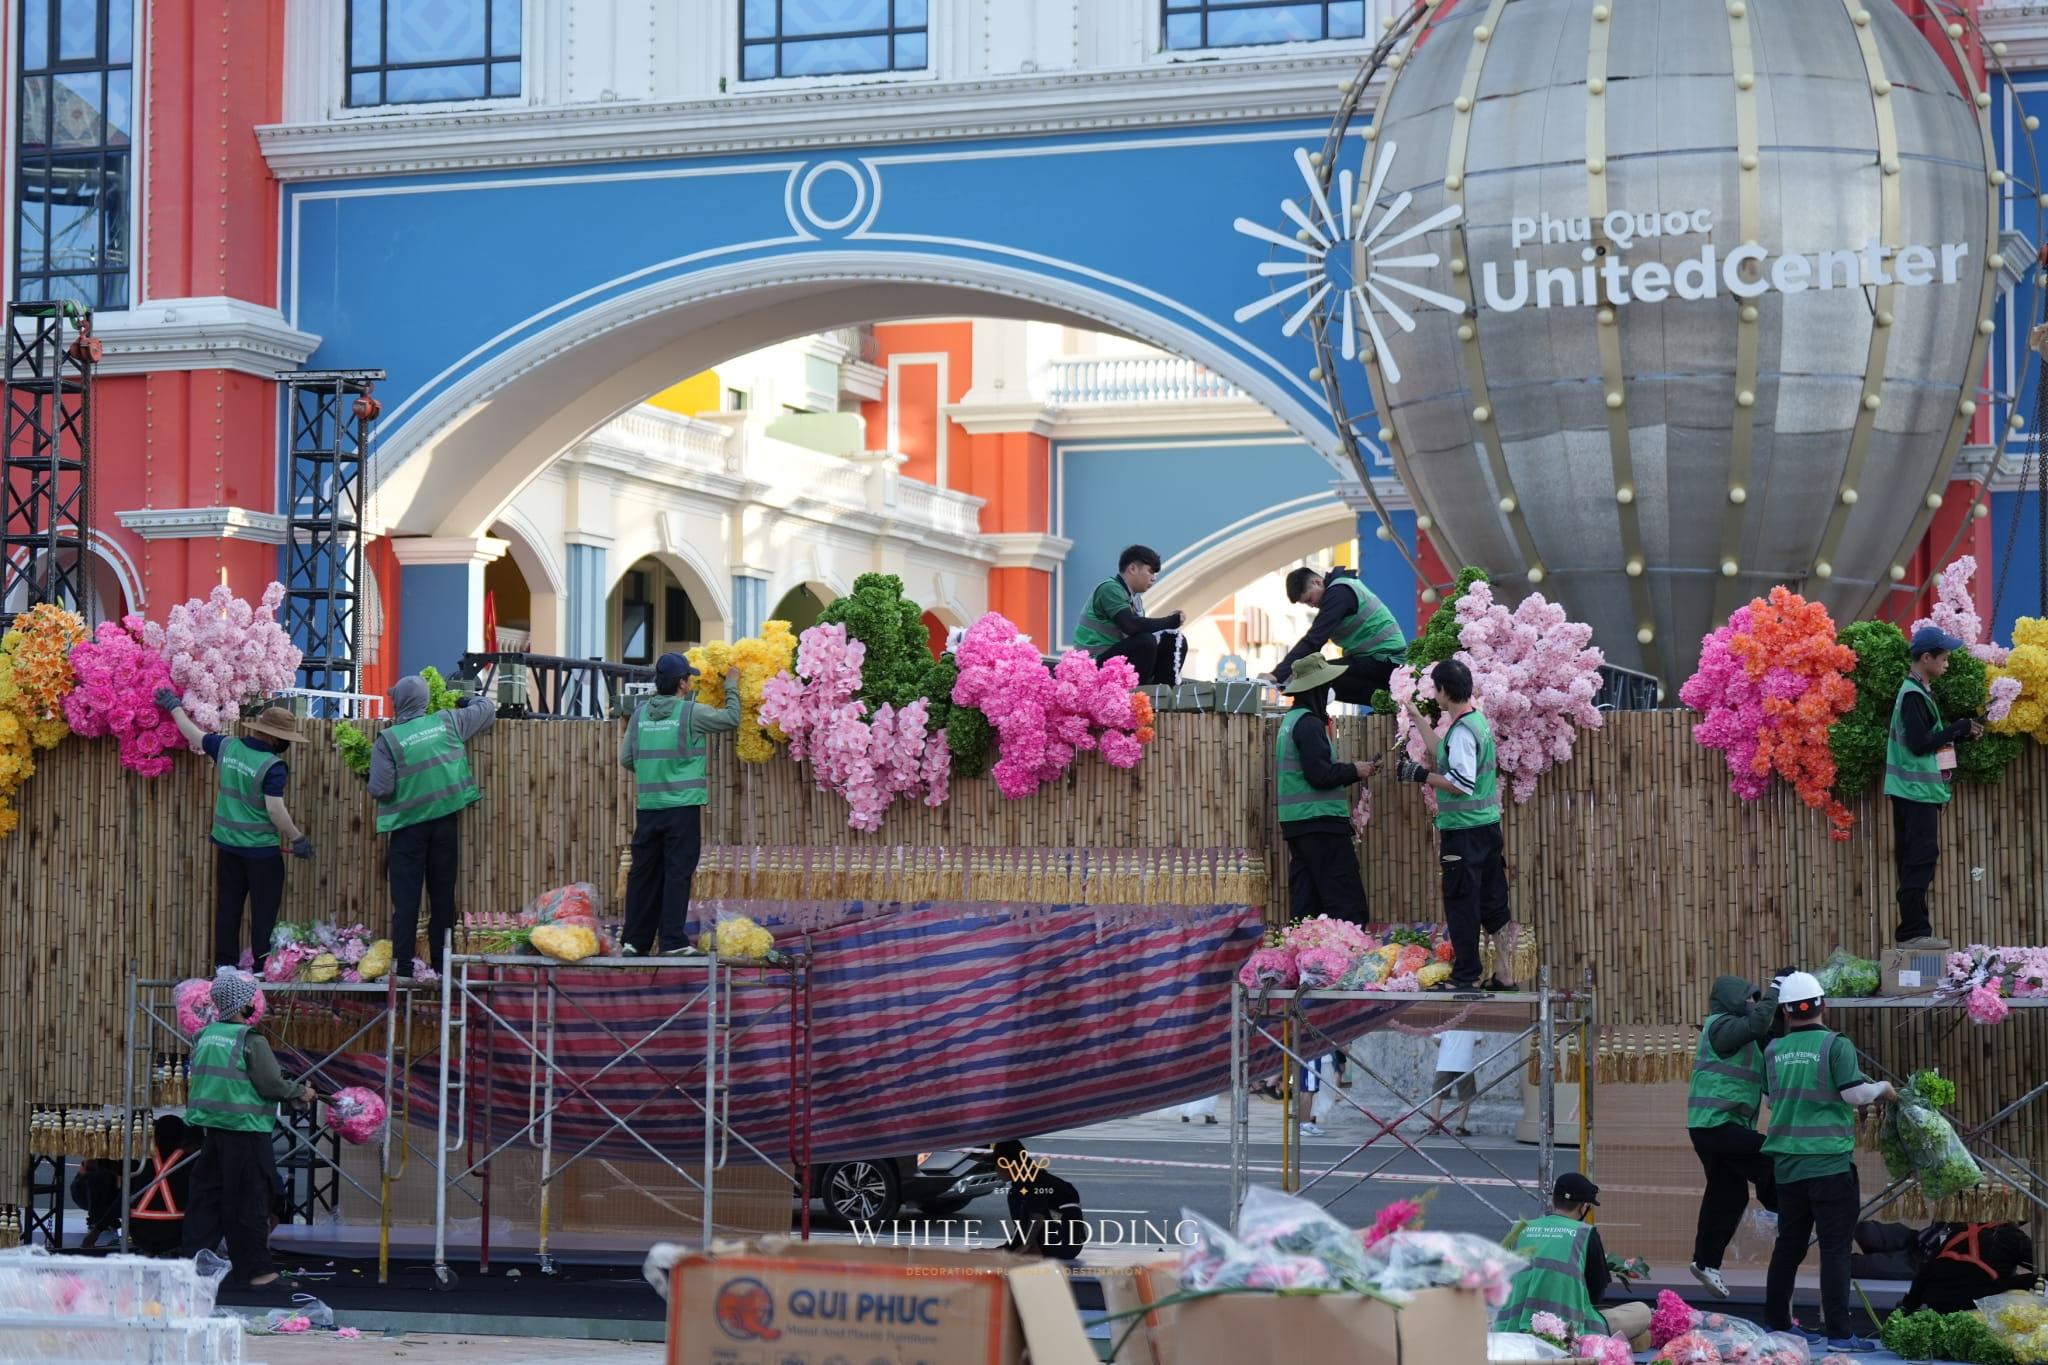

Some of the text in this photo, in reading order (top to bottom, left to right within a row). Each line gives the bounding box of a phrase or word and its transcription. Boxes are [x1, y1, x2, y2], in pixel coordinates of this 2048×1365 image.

[1512, 208, 1713, 248] Phu Quoc
[788, 1289, 939, 1326] QUI PHUC
